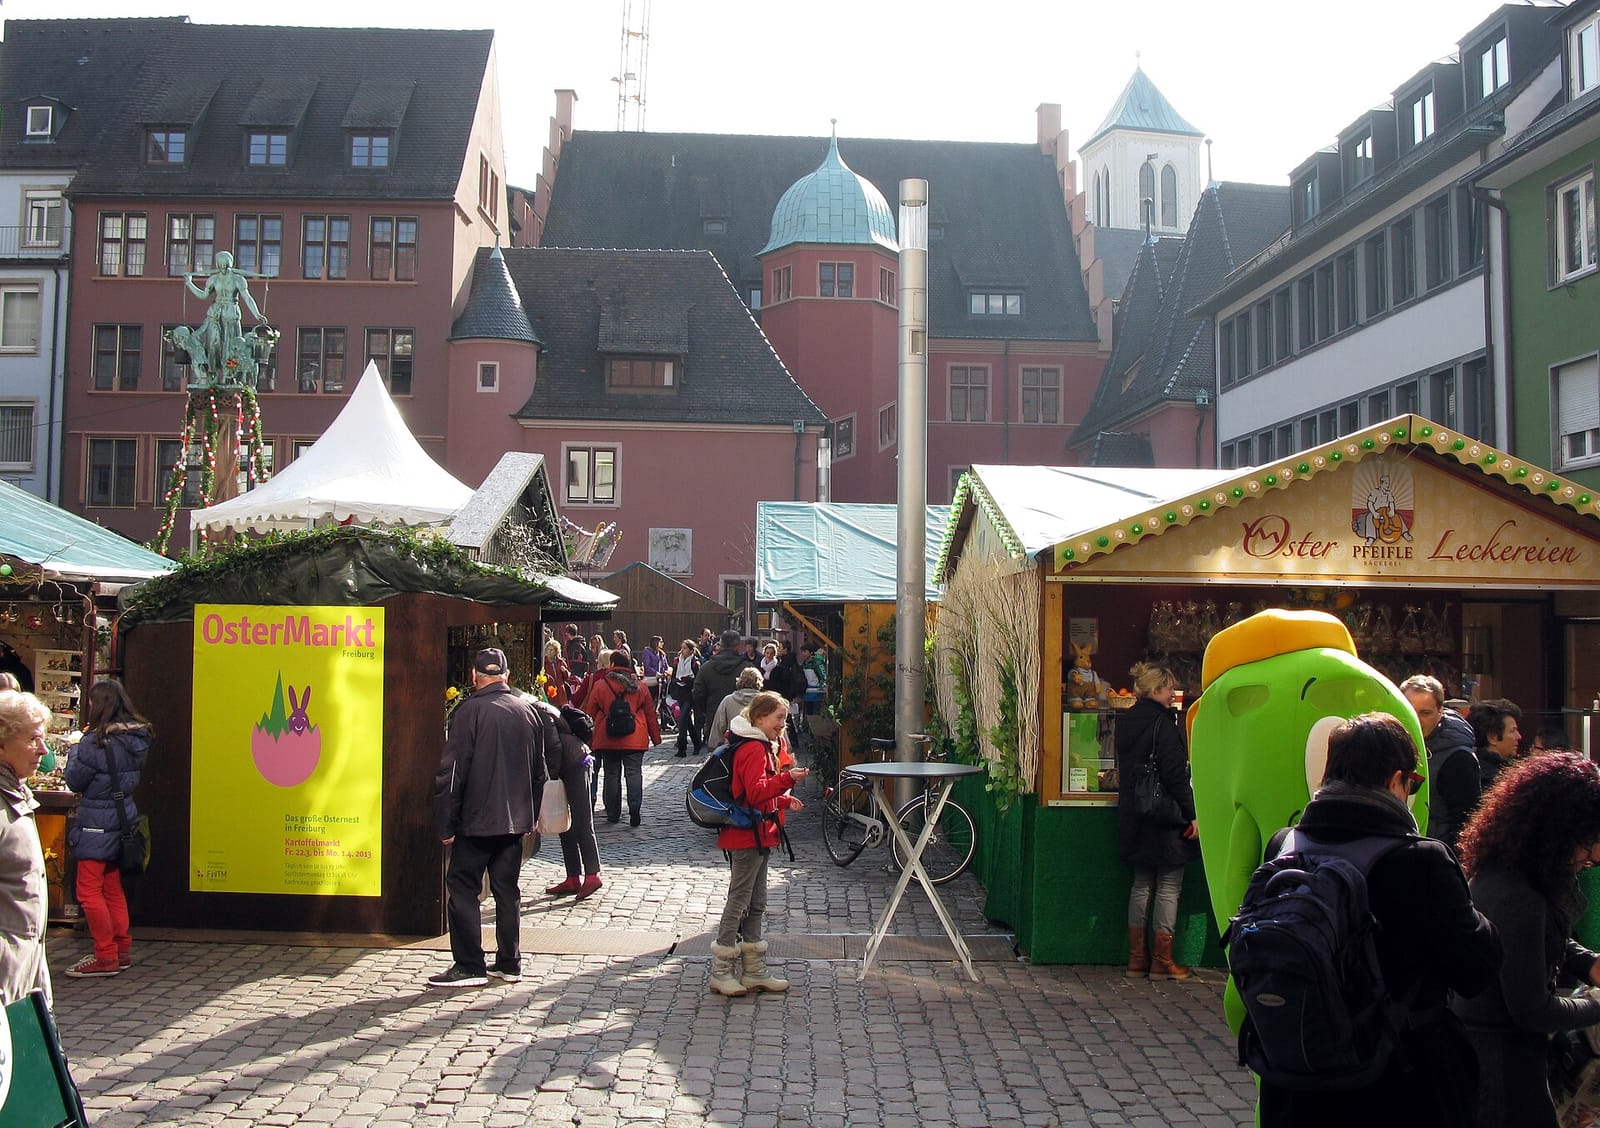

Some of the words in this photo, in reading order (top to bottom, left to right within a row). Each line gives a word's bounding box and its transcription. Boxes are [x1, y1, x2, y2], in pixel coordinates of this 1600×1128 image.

[1242, 514, 1339, 560] Oster
[1428, 520, 1582, 564] Leckereien
[1352, 545, 1413, 559] PFEIFLE
[202, 613, 376, 647] OsterMarkt
[342, 650, 375, 659] Freiburg
[285, 814, 298, 822] Das
[300, 814, 322, 824] große
[323, 815, 360, 824] Osternest
[285, 824, 292, 832] in
[294, 824, 326, 834] Freiburg
[285, 838, 341, 847] Kartoffelmarkt
[285, 848, 294, 856] Fr.
[296, 849, 312, 857] 22.3.
[313, 849, 324, 857] bis
[326, 849, 340, 857] Mo.
[341, 850, 354, 858] 1.4.
[355, 851, 372, 859] 2013
[206, 870, 227, 878] FWTM
